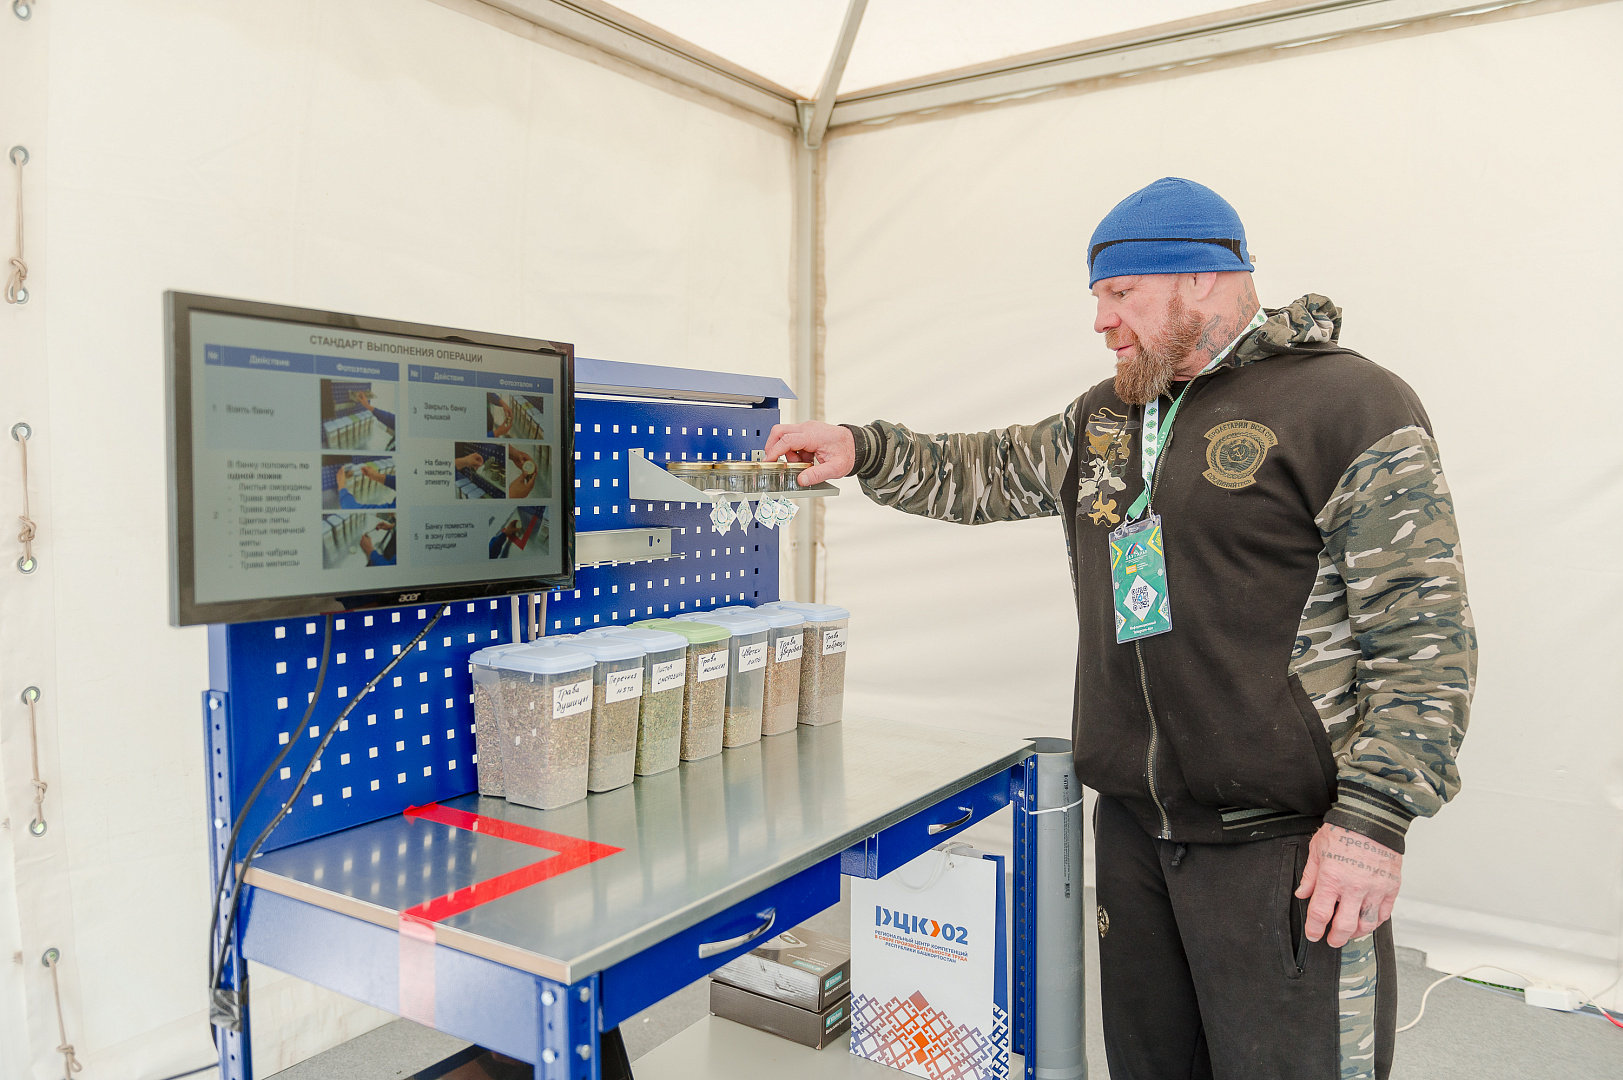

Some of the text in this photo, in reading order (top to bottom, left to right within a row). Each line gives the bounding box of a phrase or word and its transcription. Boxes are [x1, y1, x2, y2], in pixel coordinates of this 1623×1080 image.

[309, 334, 483, 363] СТАНДАРТ ВЫПОЛНЕНИЯ ОПЕРАЦИИ
[424, 402, 467, 413] Закрыть банку
[424, 413, 450, 421] крышкой
[1208, 422, 1248, 440] ПРОЛЕТАРИИ
[1250, 422, 1266, 434] ВСЕХ
[435, 460, 452, 468] банку
[425, 479, 450, 487] этикетку
[1206, 472, 1252, 489] СОЕДИНЯЙТЕСЬ
[425, 522, 475, 531] Банку поместить
[430, 533, 444, 541] зону
[445, 531, 468, 539] готовой
[425, 542, 457, 551] продукции
[398, 592, 422, 602] acer
[1339, 835, 1397, 861] гребаных
[874, 930, 969, 957] РЕГИОНАЛЬНЫЙ ЦЕНТР КОМПЕТЕНЦИЙ
[885, 941, 957, 963] РЕСПУБЛИКИ БАШКОРТОСТАН
[894, 940, 951, 957] ПРОИЗВОДИТЕЛЬНОСТИ
[951, 953, 968, 962] ТРУДА
